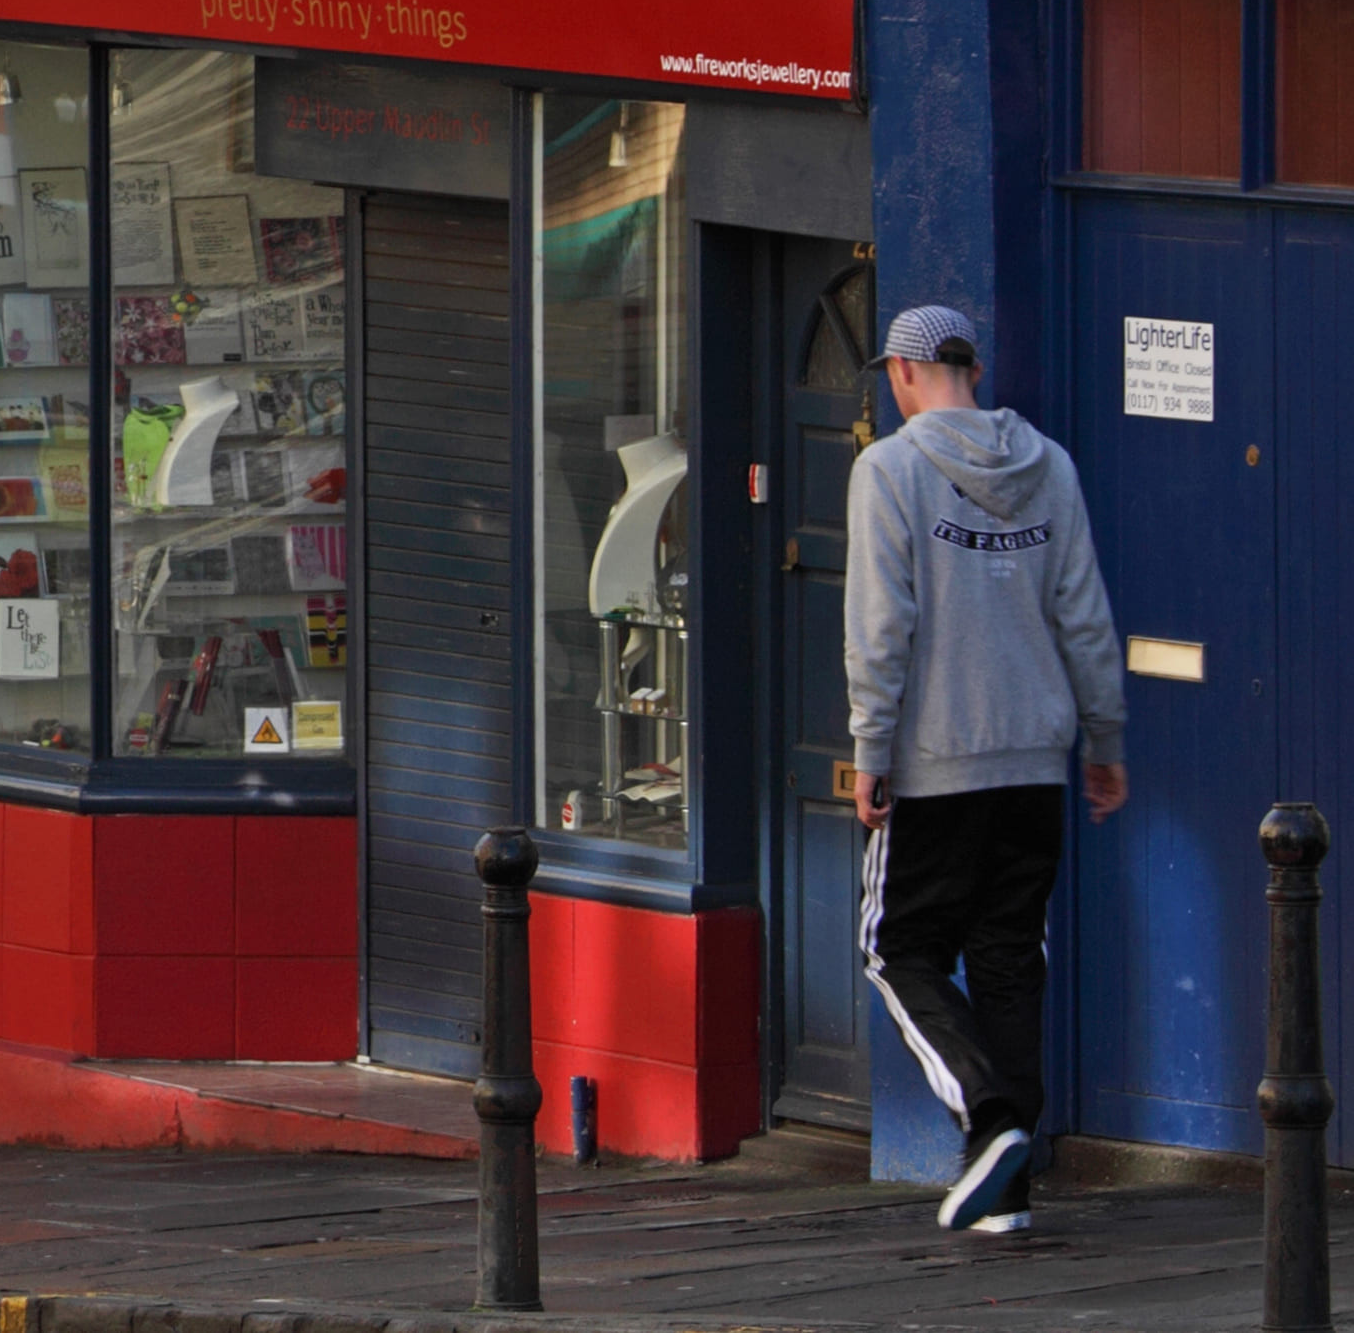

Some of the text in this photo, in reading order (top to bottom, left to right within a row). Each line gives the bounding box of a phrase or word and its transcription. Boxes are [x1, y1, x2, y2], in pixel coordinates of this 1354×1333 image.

[385, 0, 467, 48] things
[660, 53, 852, 89] www.fireworksjewellery.com
[1127, 320, 1211, 352] LighterLife
[1127, 357, 1211, 376] Bristol Office Closed
[1127, 393, 1157, 413] (0117)
